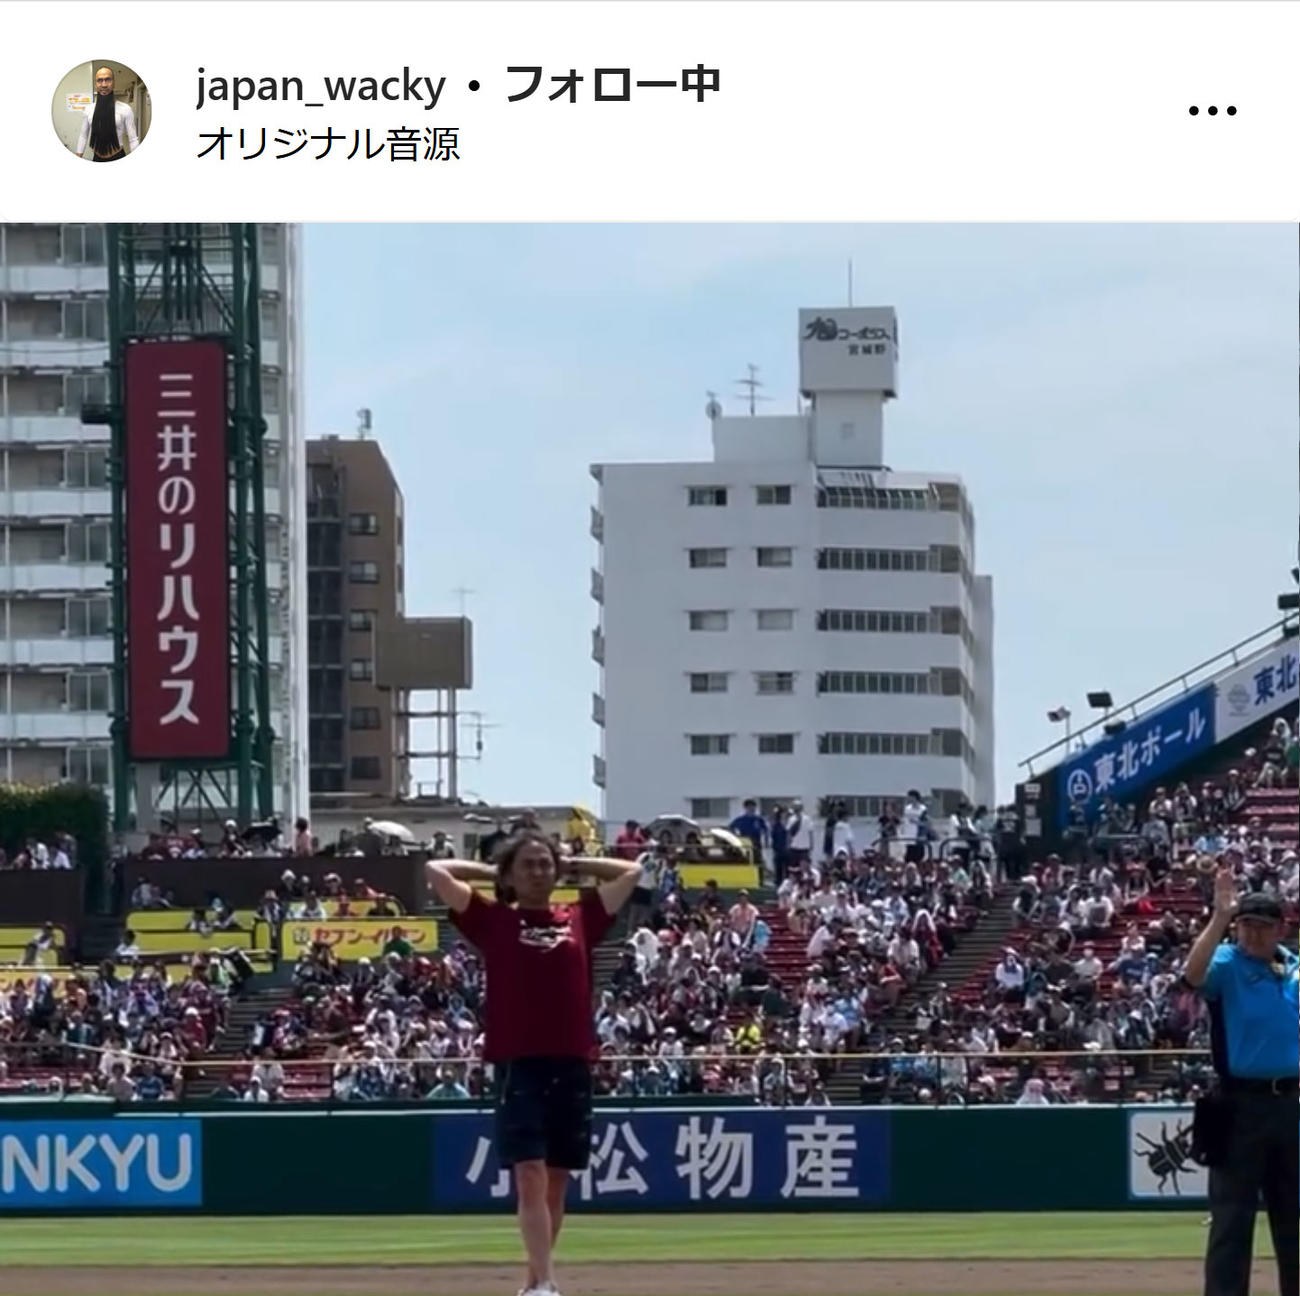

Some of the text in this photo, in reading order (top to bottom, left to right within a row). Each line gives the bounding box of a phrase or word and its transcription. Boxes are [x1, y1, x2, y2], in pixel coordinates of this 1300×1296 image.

[157, 374, 200, 725] 三井のリハウス
[1253, 654, 1297, 706] 東北
[1094, 707, 1206, 793] 東北ボール
[2, 1134, 192, 1193] NKYU
